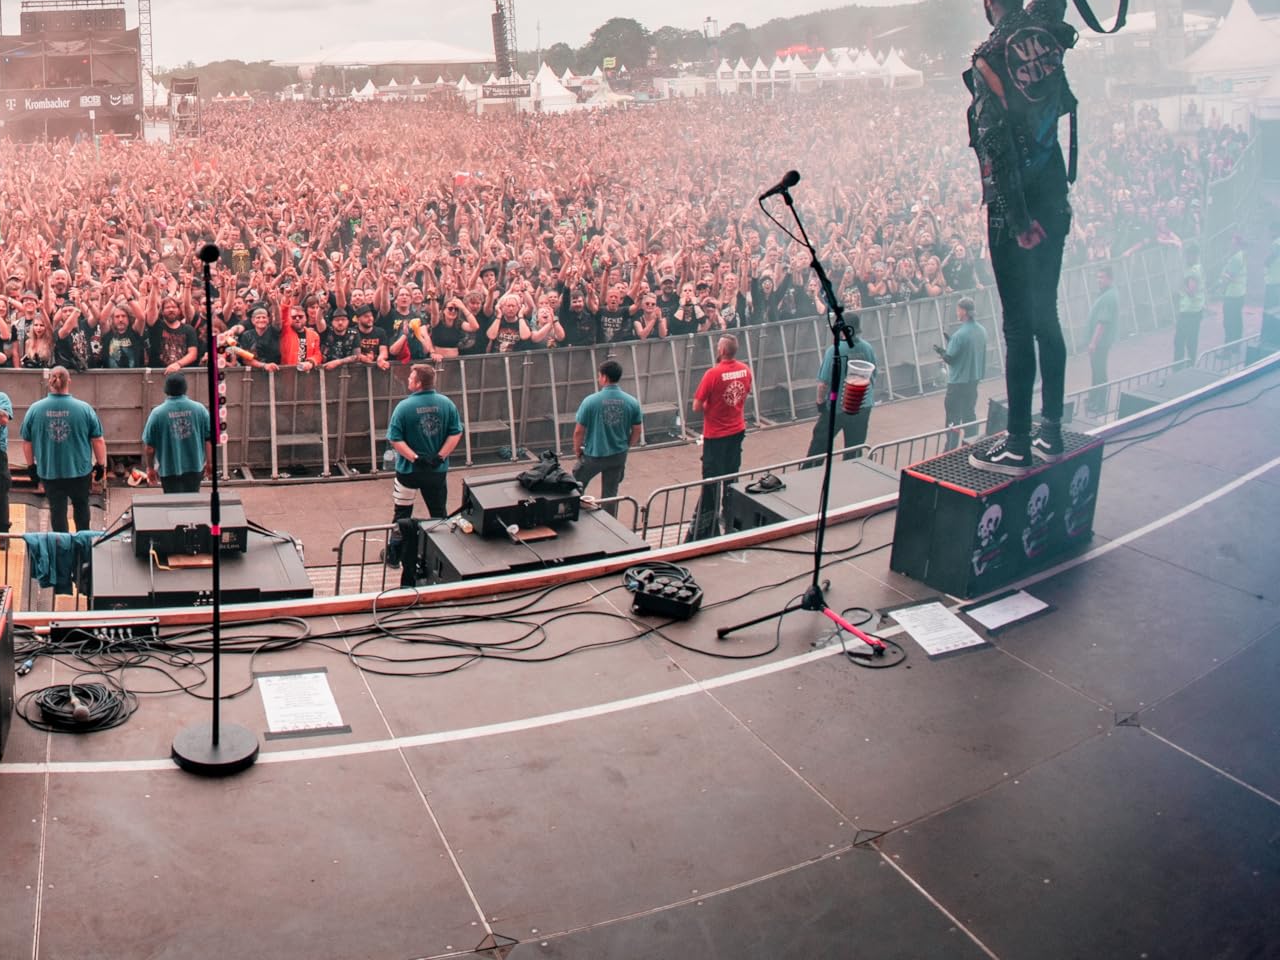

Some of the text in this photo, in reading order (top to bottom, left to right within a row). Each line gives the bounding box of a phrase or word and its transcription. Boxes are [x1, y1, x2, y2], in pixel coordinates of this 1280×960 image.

[25, 97, 71, 110] Krombacher
[722, 369, 747, 381] SECURITY
[168, 410, 192, 419] SECURITY
